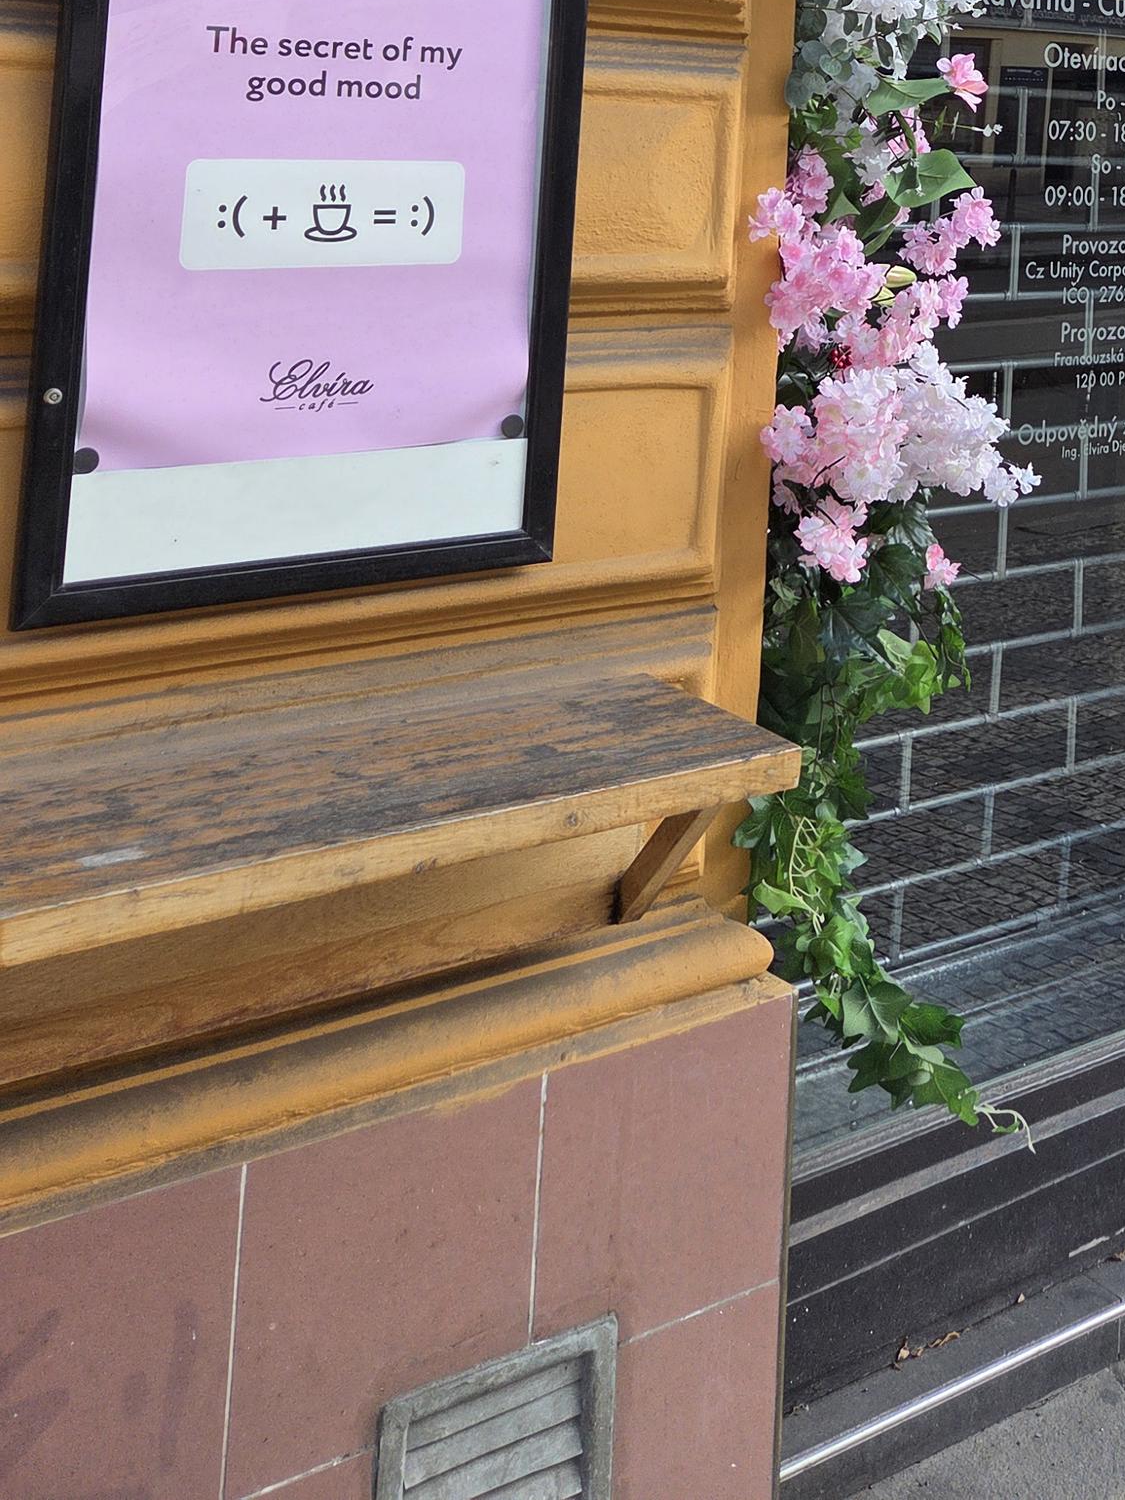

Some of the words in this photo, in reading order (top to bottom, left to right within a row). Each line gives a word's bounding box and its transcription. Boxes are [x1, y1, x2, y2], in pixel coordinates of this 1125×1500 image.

[206, 25, 269, 55] The
[278, 36, 373, 61] secret
[382, 37, 414, 62] of
[420, 44, 463, 70] my
[245, 70, 327, 101] good
[336, 74, 421, 99] mood
[1097, 91, 1115, 111] Po
[1048, 120, 1096, 142] 07:30
[1091, 153, 1109, 174] So
[1045, 186, 1095, 207] 09:00
[1025, 261, 1045, 280] Cz
[1049, 261, 1085, 286] Unity
[1054, 347, 1124, 367] Francouzská
[1076, 372, 1096, 389] 120
[1100, 371, 1115, 387] 00
[298, 399, 335, 413] café
[1017, 415, 1118, 447] Odpovědný
[1061, 445, 1080, 461] Ing.
